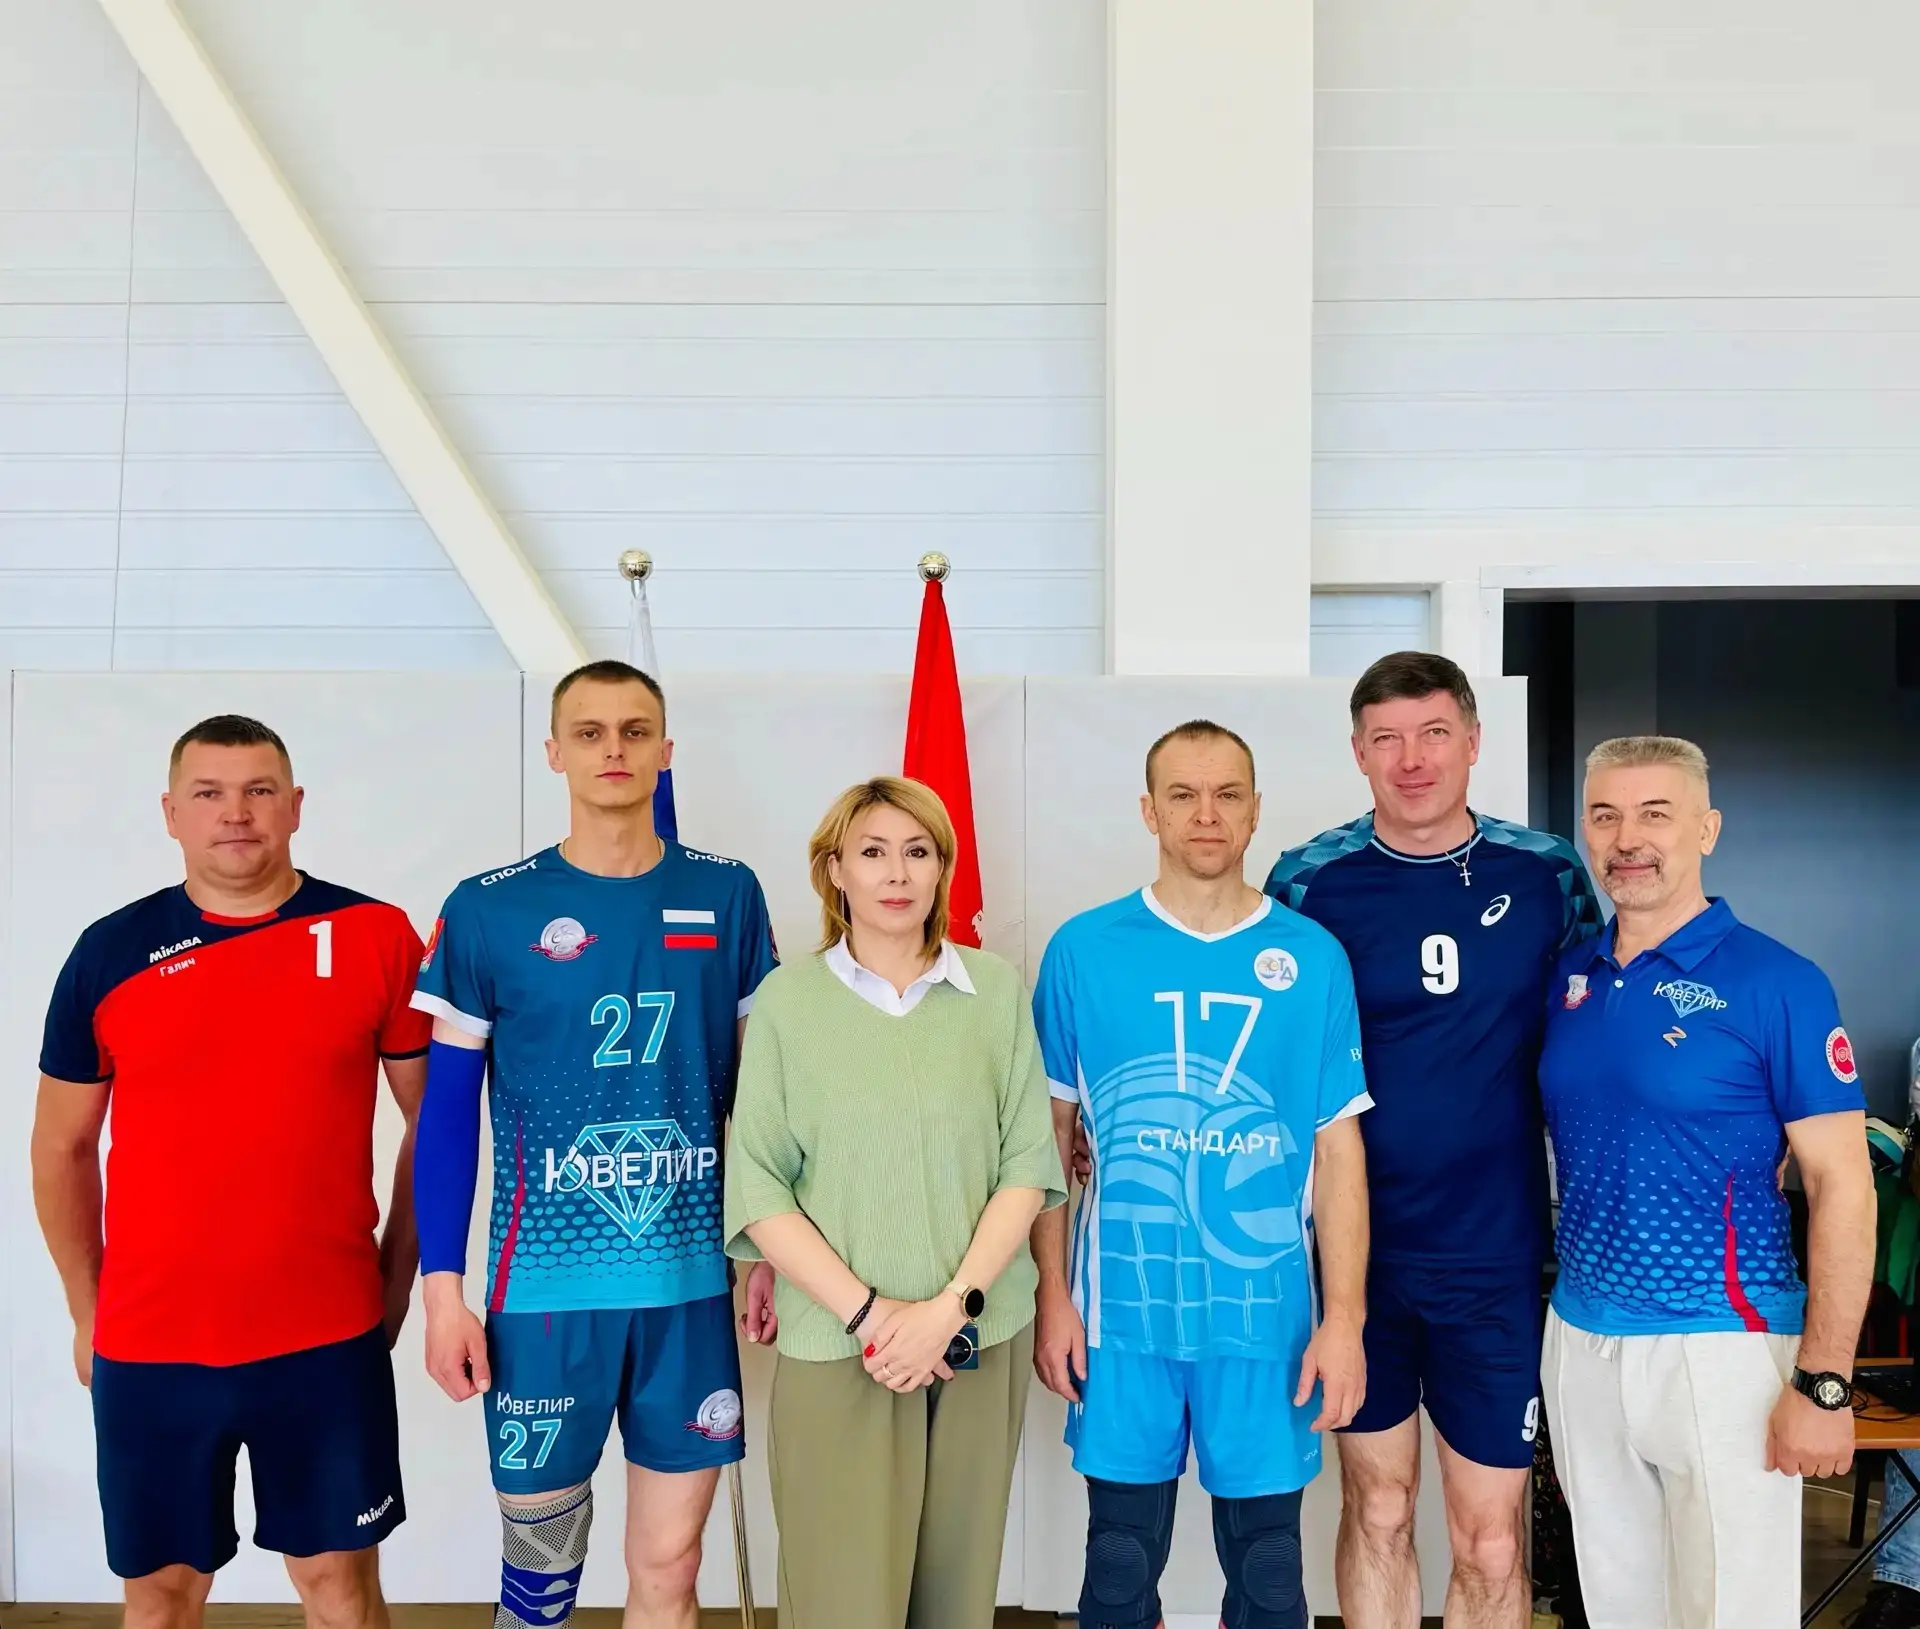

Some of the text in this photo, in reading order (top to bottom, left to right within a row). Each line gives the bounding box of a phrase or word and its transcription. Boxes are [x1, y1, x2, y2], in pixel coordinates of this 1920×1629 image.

[685, 850, 740, 867] СПОРТ
[159, 957, 196, 978] Галич
[308, 920, 333, 978] 1
[1421, 934, 1460, 995] 9
[1652, 981, 1728, 1011] ЮВЕЛИР
[590, 991, 676, 1069] 27
[1154, 991, 1263, 1095] 17
[1137, 1128, 1280, 1158] СТАНДАРТ
[544, 1143, 718, 1193] ЮВЕЛИР
[496, 1391, 575, 1415] ЮВЕЛИР
[1521, 1397, 1540, 1442] 9
[499, 1418, 562, 1470] 27
